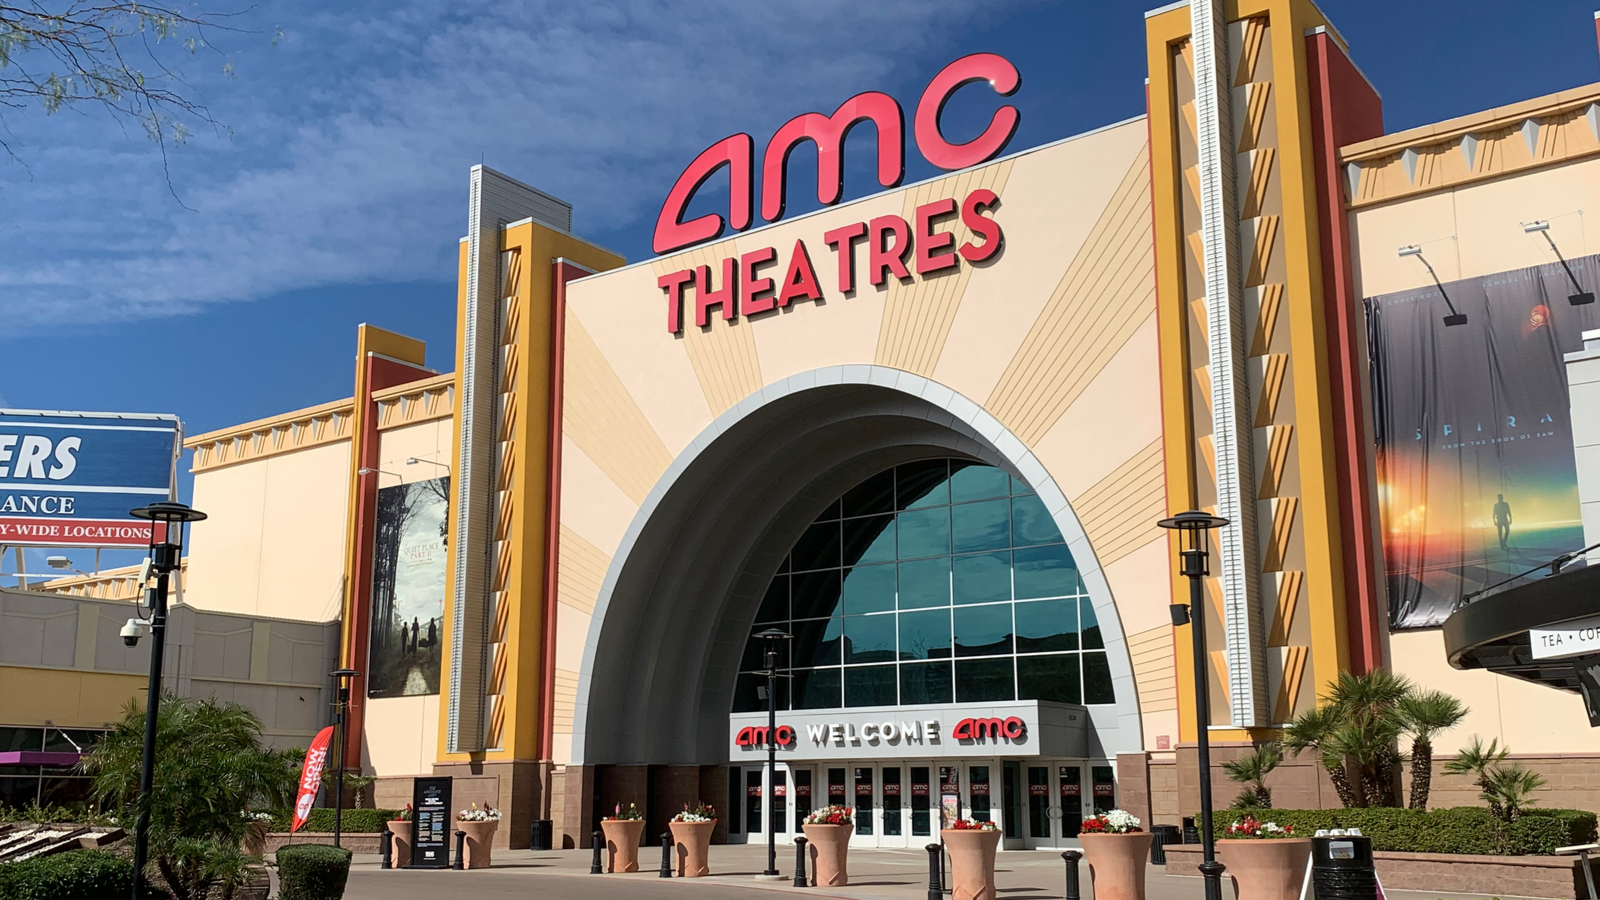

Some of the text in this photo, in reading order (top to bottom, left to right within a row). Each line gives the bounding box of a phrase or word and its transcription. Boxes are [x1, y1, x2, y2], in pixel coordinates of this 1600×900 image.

[657, 189, 1004, 336] THEATRES
[1539, 265, 1583, 278] JACKON
[1420, 291, 1443, 299] ROC
[1442, 442, 1466, 450] FROM
[1491, 436, 1515, 444] BOOK
[0, 434, 82, 480] ERS
[0, 495, 75, 514] ANCE
[0, 524, 152, 539] Y-WIDE LOCATIONS
[422, 542, 439, 551] PLACE
[1541, 633, 1564, 647] TEA
[806, 720, 938, 742] WELCOME
[303, 748, 319, 790] NOW
